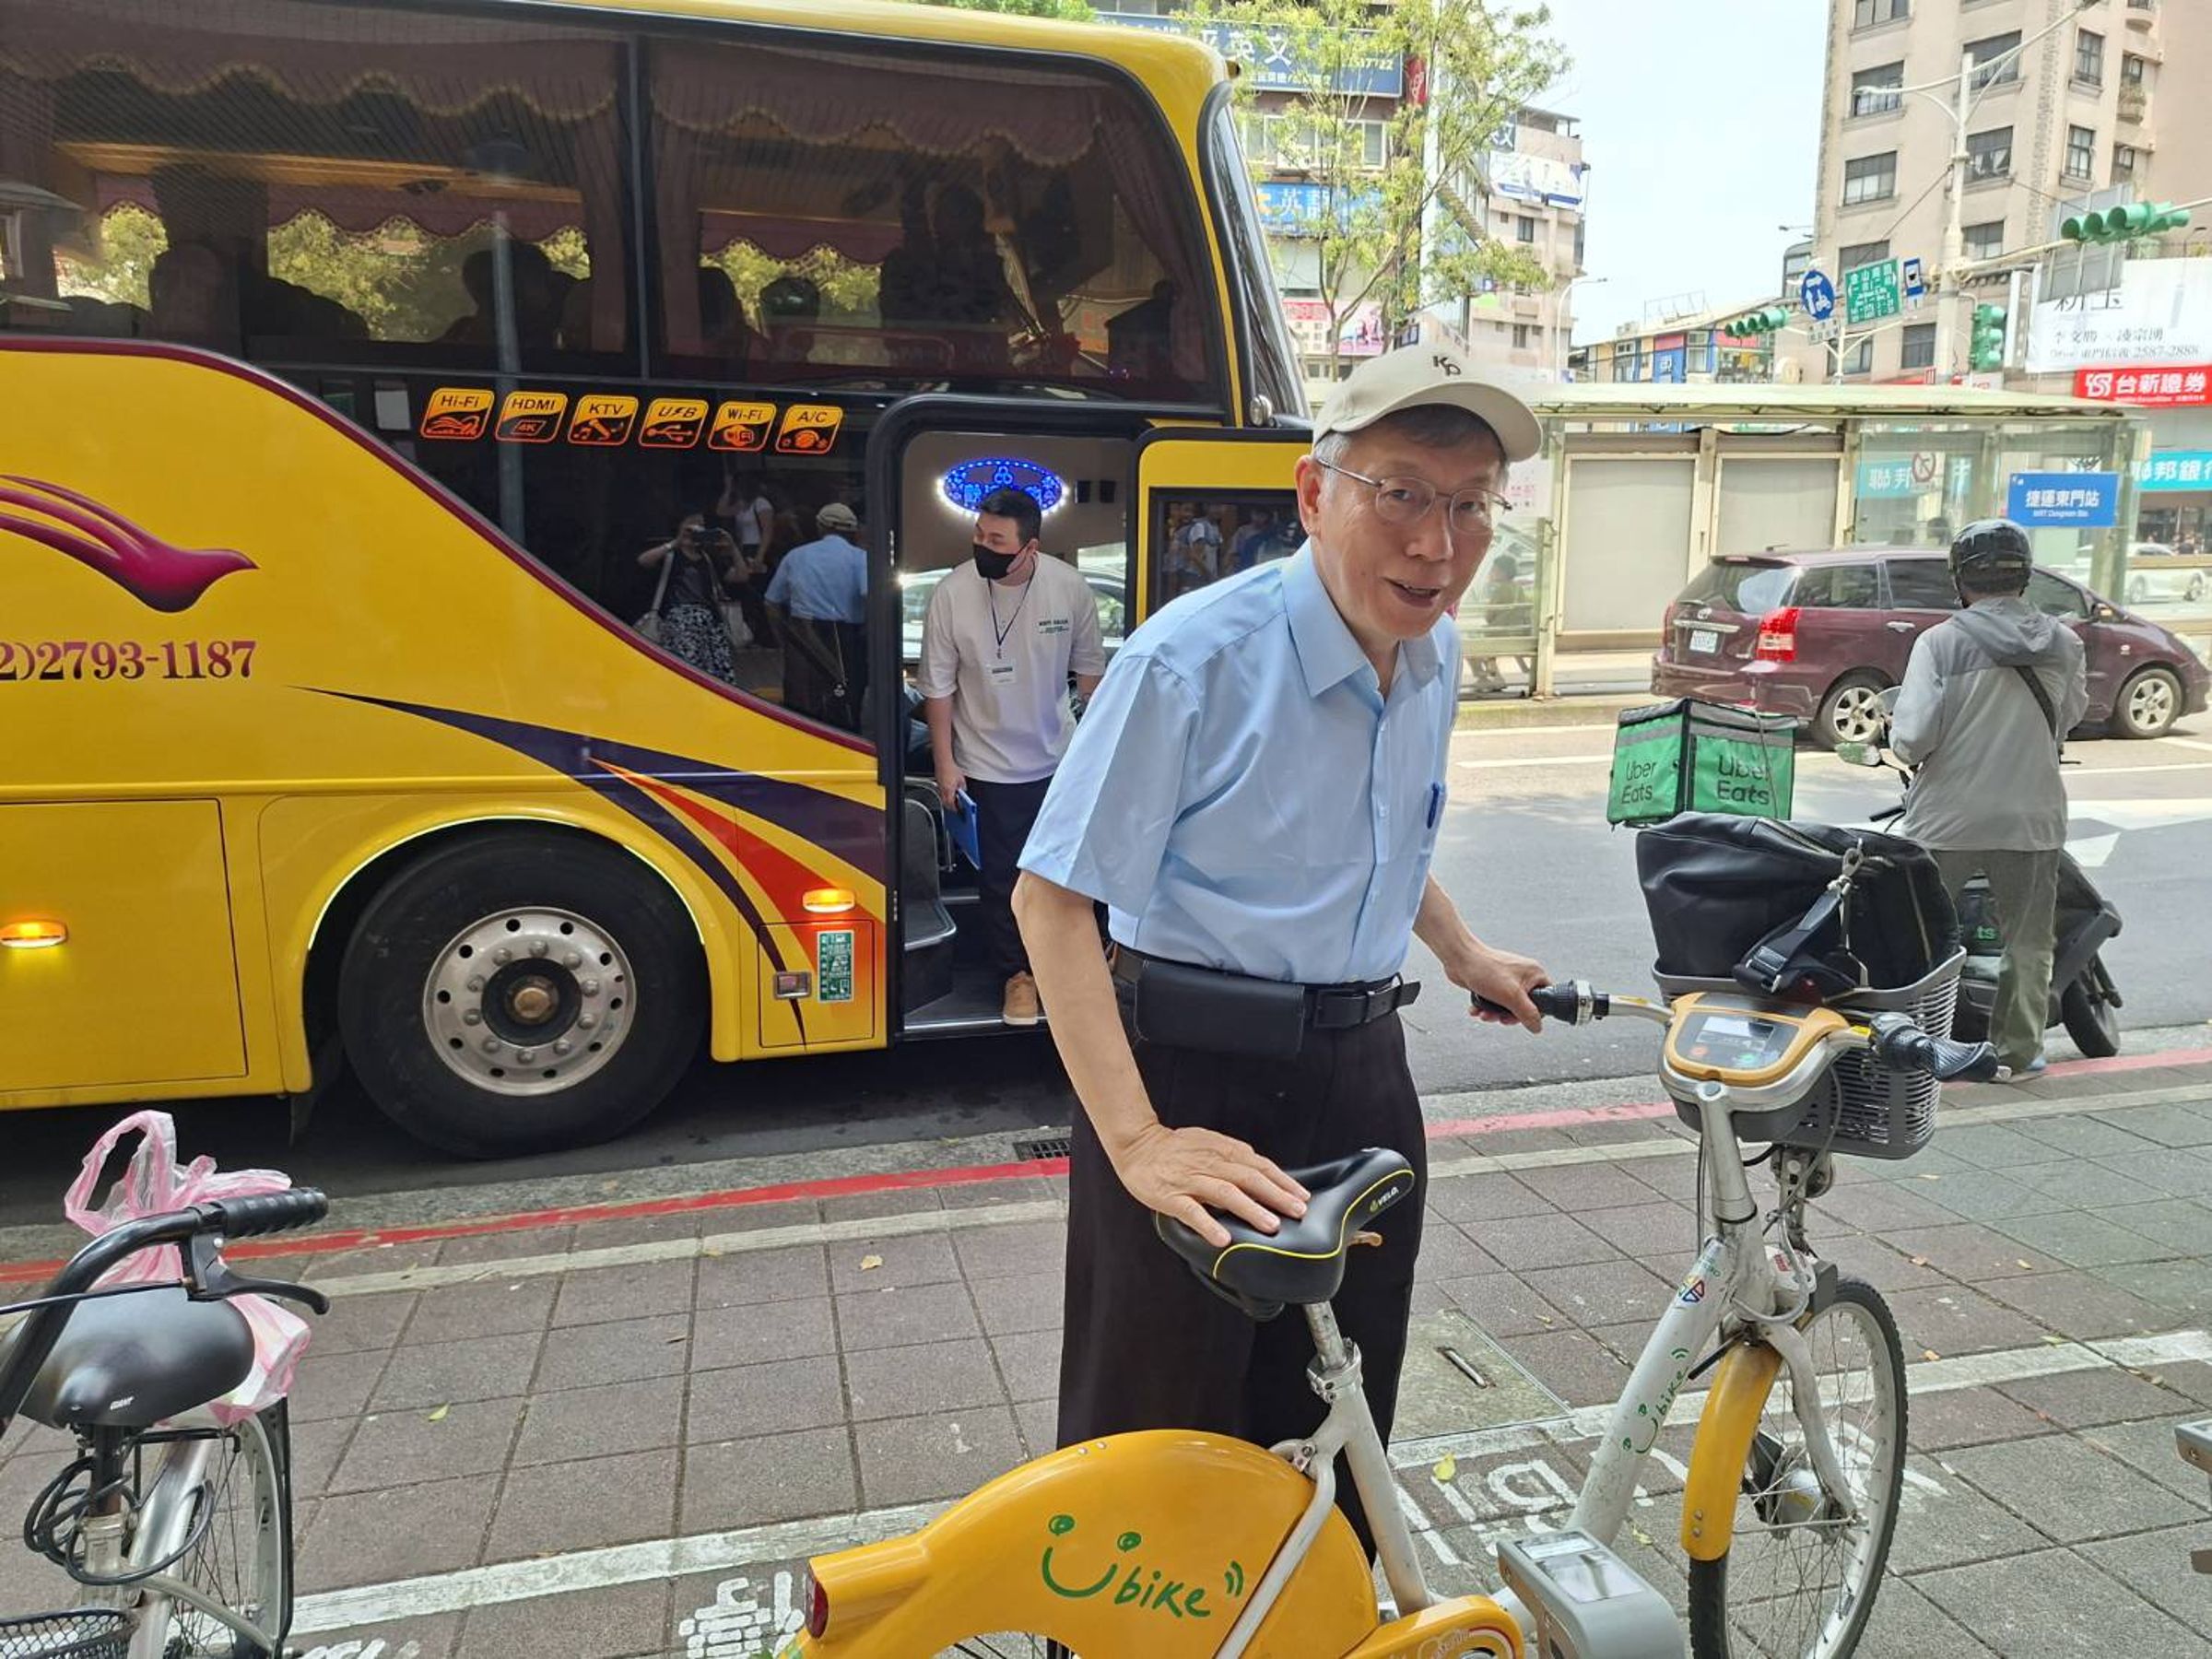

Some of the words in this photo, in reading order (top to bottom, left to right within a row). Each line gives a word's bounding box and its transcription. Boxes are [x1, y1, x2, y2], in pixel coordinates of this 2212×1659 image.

[441, 394, 480, 408] Hi-Fi
[512, 396, 556, 411] HDMI
[589, 403, 624, 416] KTV
[728, 408, 763, 421] Wi-Fi
[797, 410, 828, 423] A/C
[2025, 489, 2100, 508] 捷運東門站
[1626, 760, 1657, 782] Uber
[1718, 754, 1770, 782] Uber
[1621, 783, 1653, 804] Eats
[1717, 780, 1771, 806] Eats
